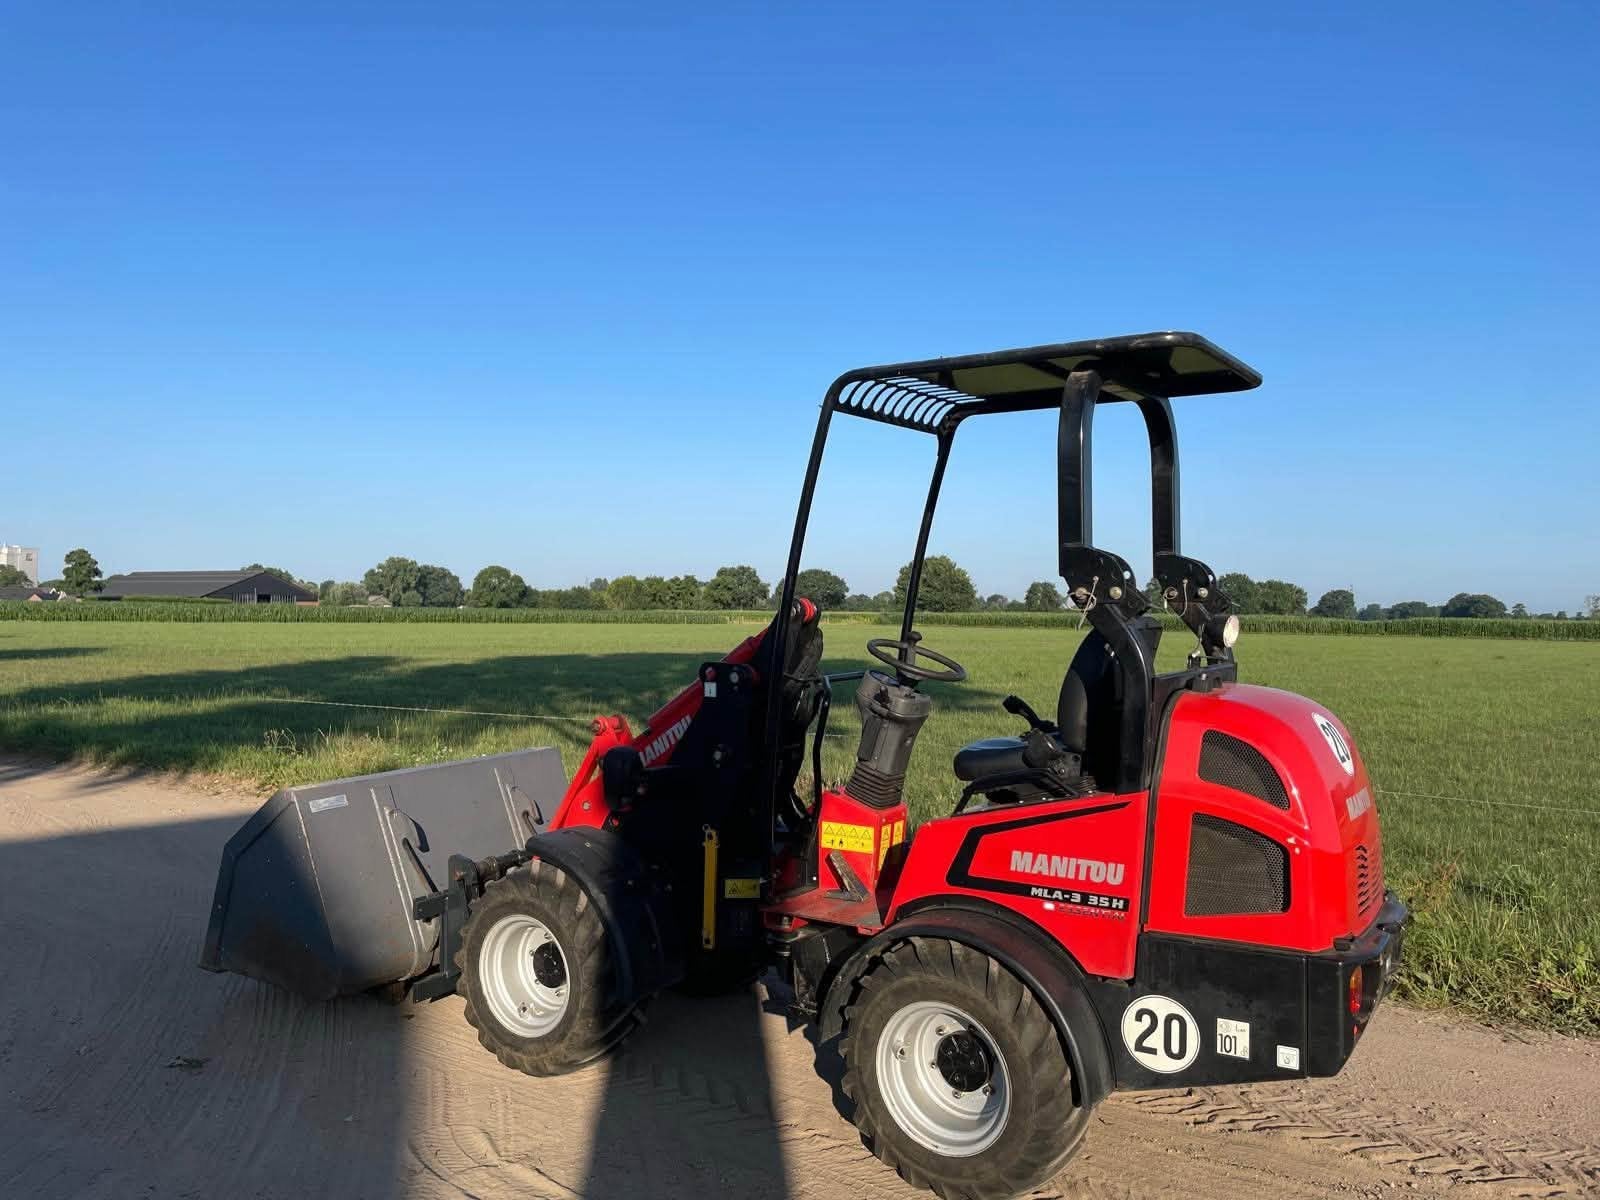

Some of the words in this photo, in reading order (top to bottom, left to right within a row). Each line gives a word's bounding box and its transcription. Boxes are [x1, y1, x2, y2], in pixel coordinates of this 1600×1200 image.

[1010, 850, 1125, 886] MANITOU
[1030, 887, 1081, 903] MLA-3
[1134, 1007, 1188, 1061] 20
[1218, 1033, 1237, 1055] 101
